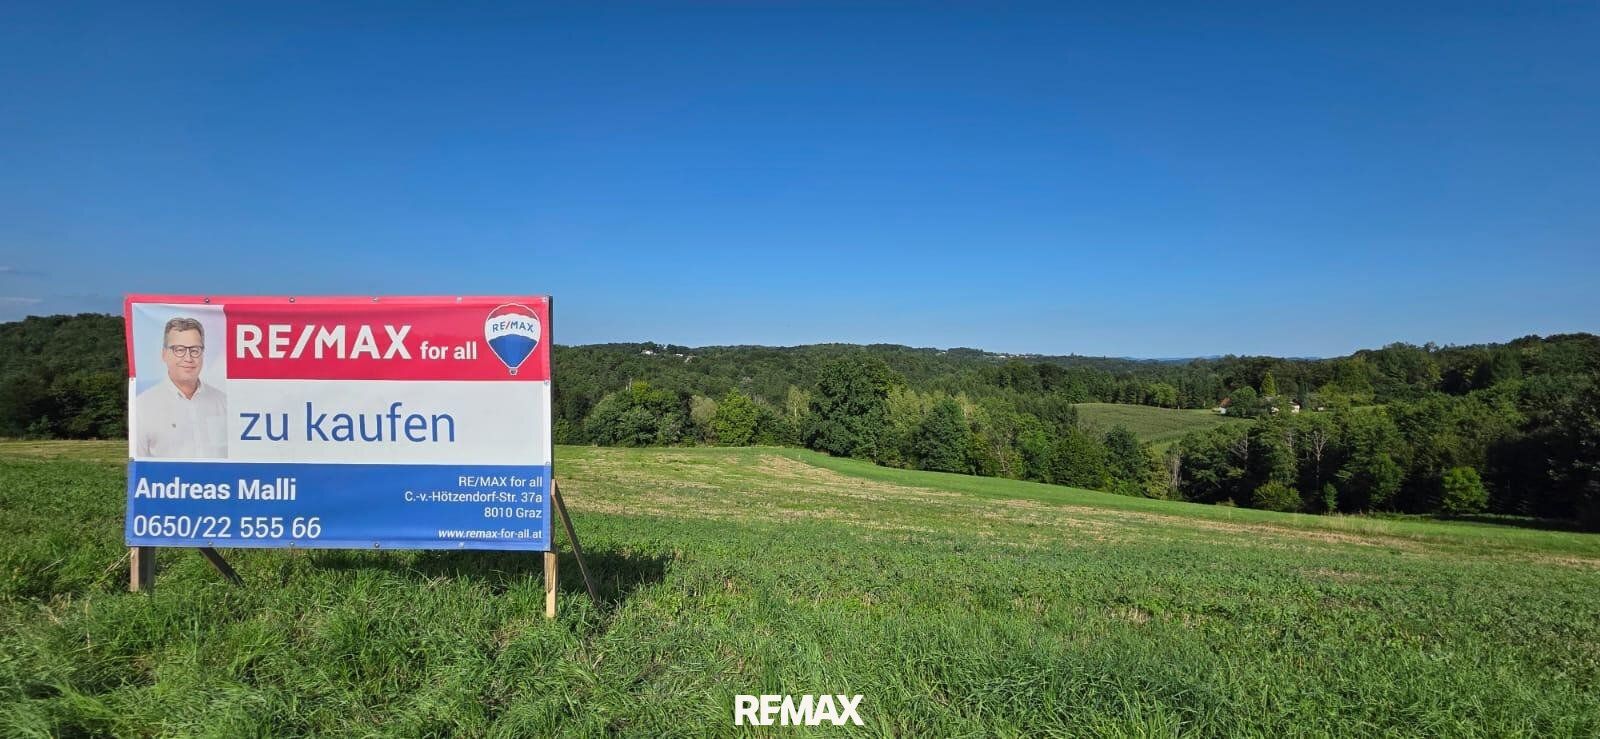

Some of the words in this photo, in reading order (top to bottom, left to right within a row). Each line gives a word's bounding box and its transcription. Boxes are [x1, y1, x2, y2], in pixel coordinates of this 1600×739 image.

[492, 320, 534, 333] RE/MAX
[235, 324, 412, 360] RE/MAX
[420, 341, 449, 360] for
[453, 341, 477, 360] all
[239, 412, 289, 441] zu
[306, 401, 455, 443] kaufen
[458, 476, 507, 487] RE/MAX
[510, 476, 526, 487] for
[529, 476, 542, 487] all
[134, 477, 230, 500] Andreas
[238, 478, 297, 501] Malli
[404, 490, 517, 503] C.-v.-Hötzendorf-Str.
[521, 492, 542, 503] 37a
[484, 507, 512, 518] 8010
[515, 507, 542, 519] Graz
[133, 515, 231, 538] 0650/22
[240, 516, 287, 538] 555
[291, 516, 321, 539] 66
[438, 528, 542, 539] www.remax-for-all.at
